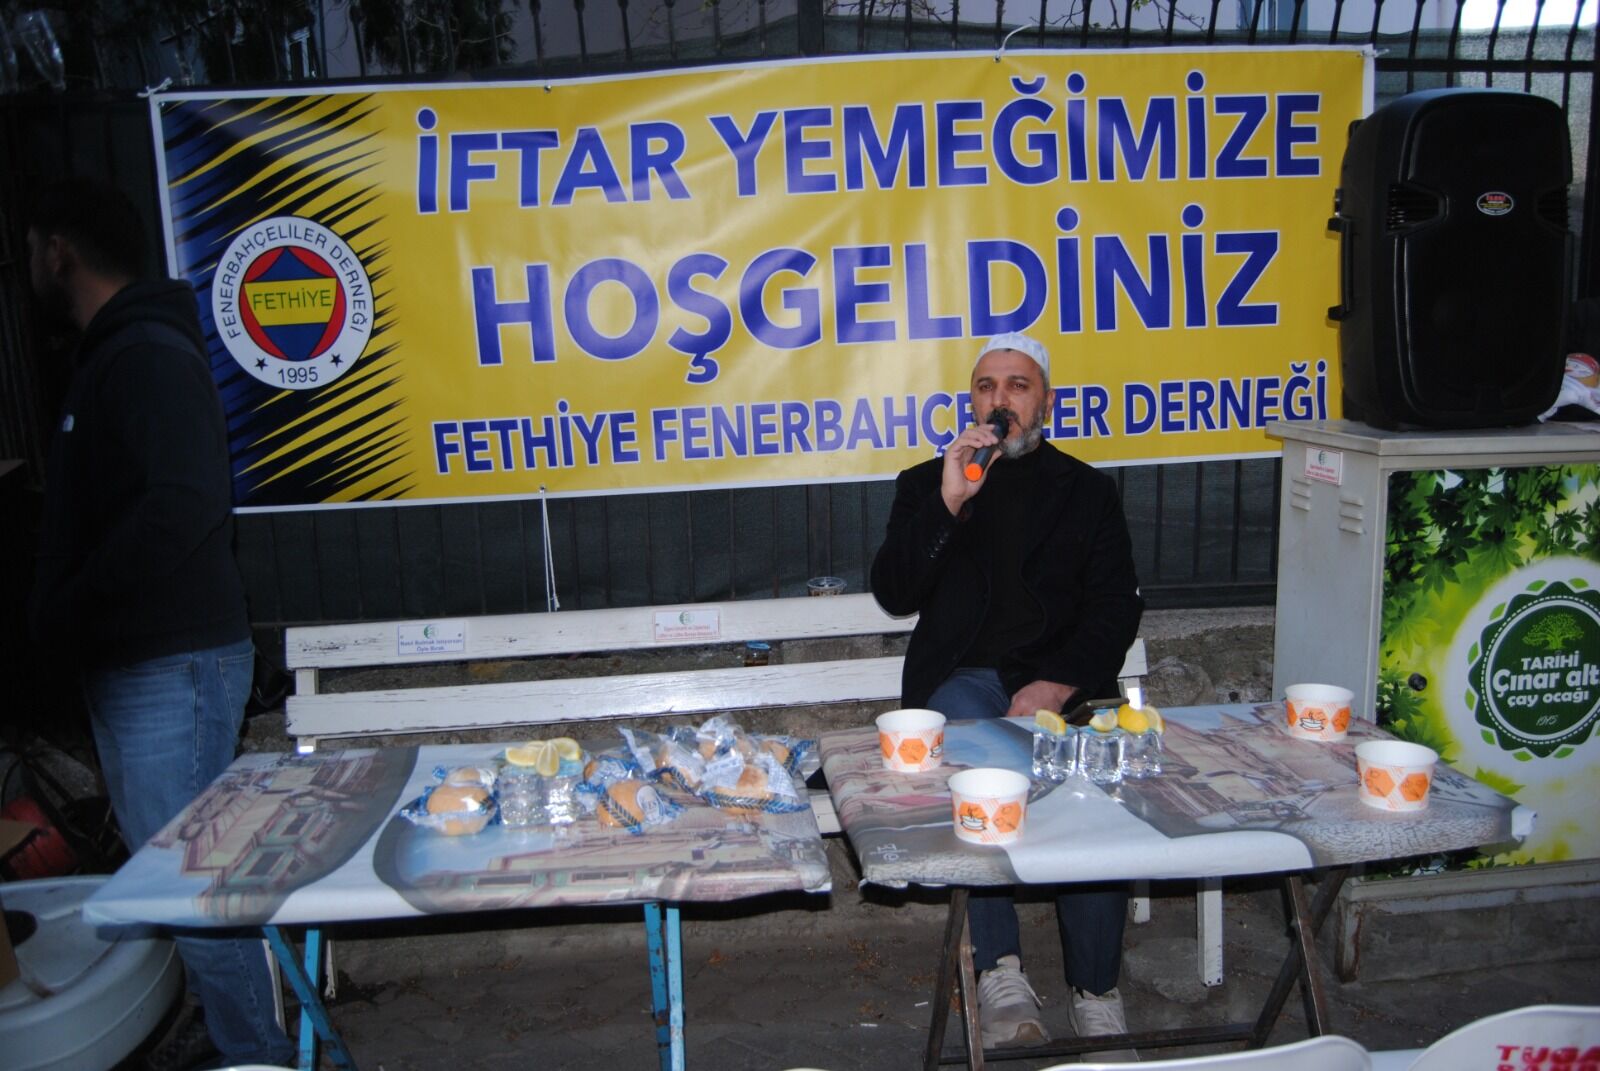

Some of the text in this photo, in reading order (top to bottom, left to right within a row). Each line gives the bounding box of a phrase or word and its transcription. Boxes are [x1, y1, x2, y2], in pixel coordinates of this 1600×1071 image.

[417, 70, 1321, 214] İFTAR YEMEĞİMİZE
[252, 287, 332, 311] FETHİYE
[471, 203, 1279, 383] HOŞGELDİNİZ
[277, 366, 319, 384] 1995
[432, 359, 1328, 475] FETHİYE FENERBAHÇEER DERNEĞİ
[1492, 663, 1600, 698] Çınar alt
[1507, 687, 1589, 708] çay ocağı
